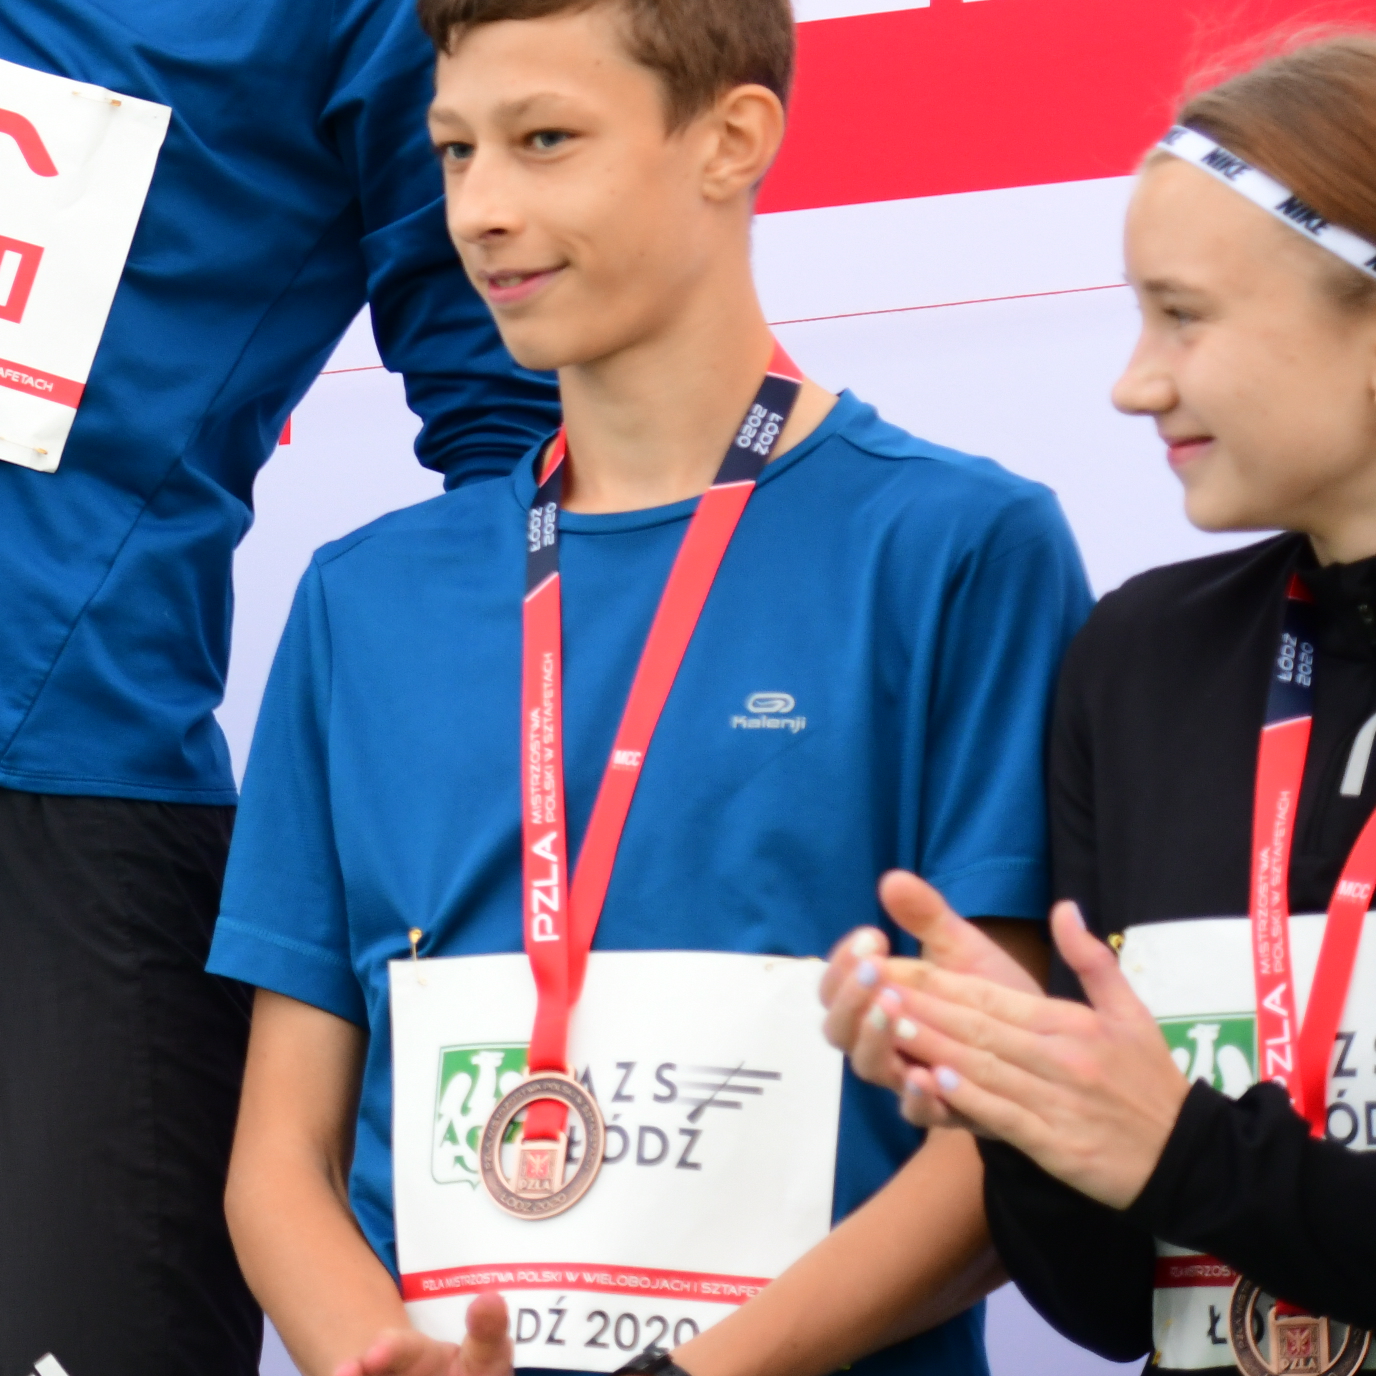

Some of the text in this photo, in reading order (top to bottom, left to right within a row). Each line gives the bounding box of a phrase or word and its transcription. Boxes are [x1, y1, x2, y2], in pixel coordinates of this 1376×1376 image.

[736, 404, 768, 448] 2020
[543, 502, 557, 547] 2020
[1295, 641, 1314, 688] 2020
[542, 652, 556, 823] POLSKI W SZTAFETACH
[731, 715, 806, 734] Kalenji
[529, 707, 542, 824] MISTRZOSTWA
[613, 749, 642, 767] MCC
[1269, 790, 1291, 887] SZTAFETACH
[532, 831, 560, 942] PZLA
[1270, 909, 1285, 973] POLSKI
[447, 1272, 514, 1289] MISTRZOSTWA
[516, 1270, 562, 1283] POLSKI
[565, 1271, 579, 1282] W
[582, 1272, 691, 1292] WIELOBOJACH
[701, 1282, 765, 1298] SZTAFET
[515, 1296, 569, 1346] DŹ
